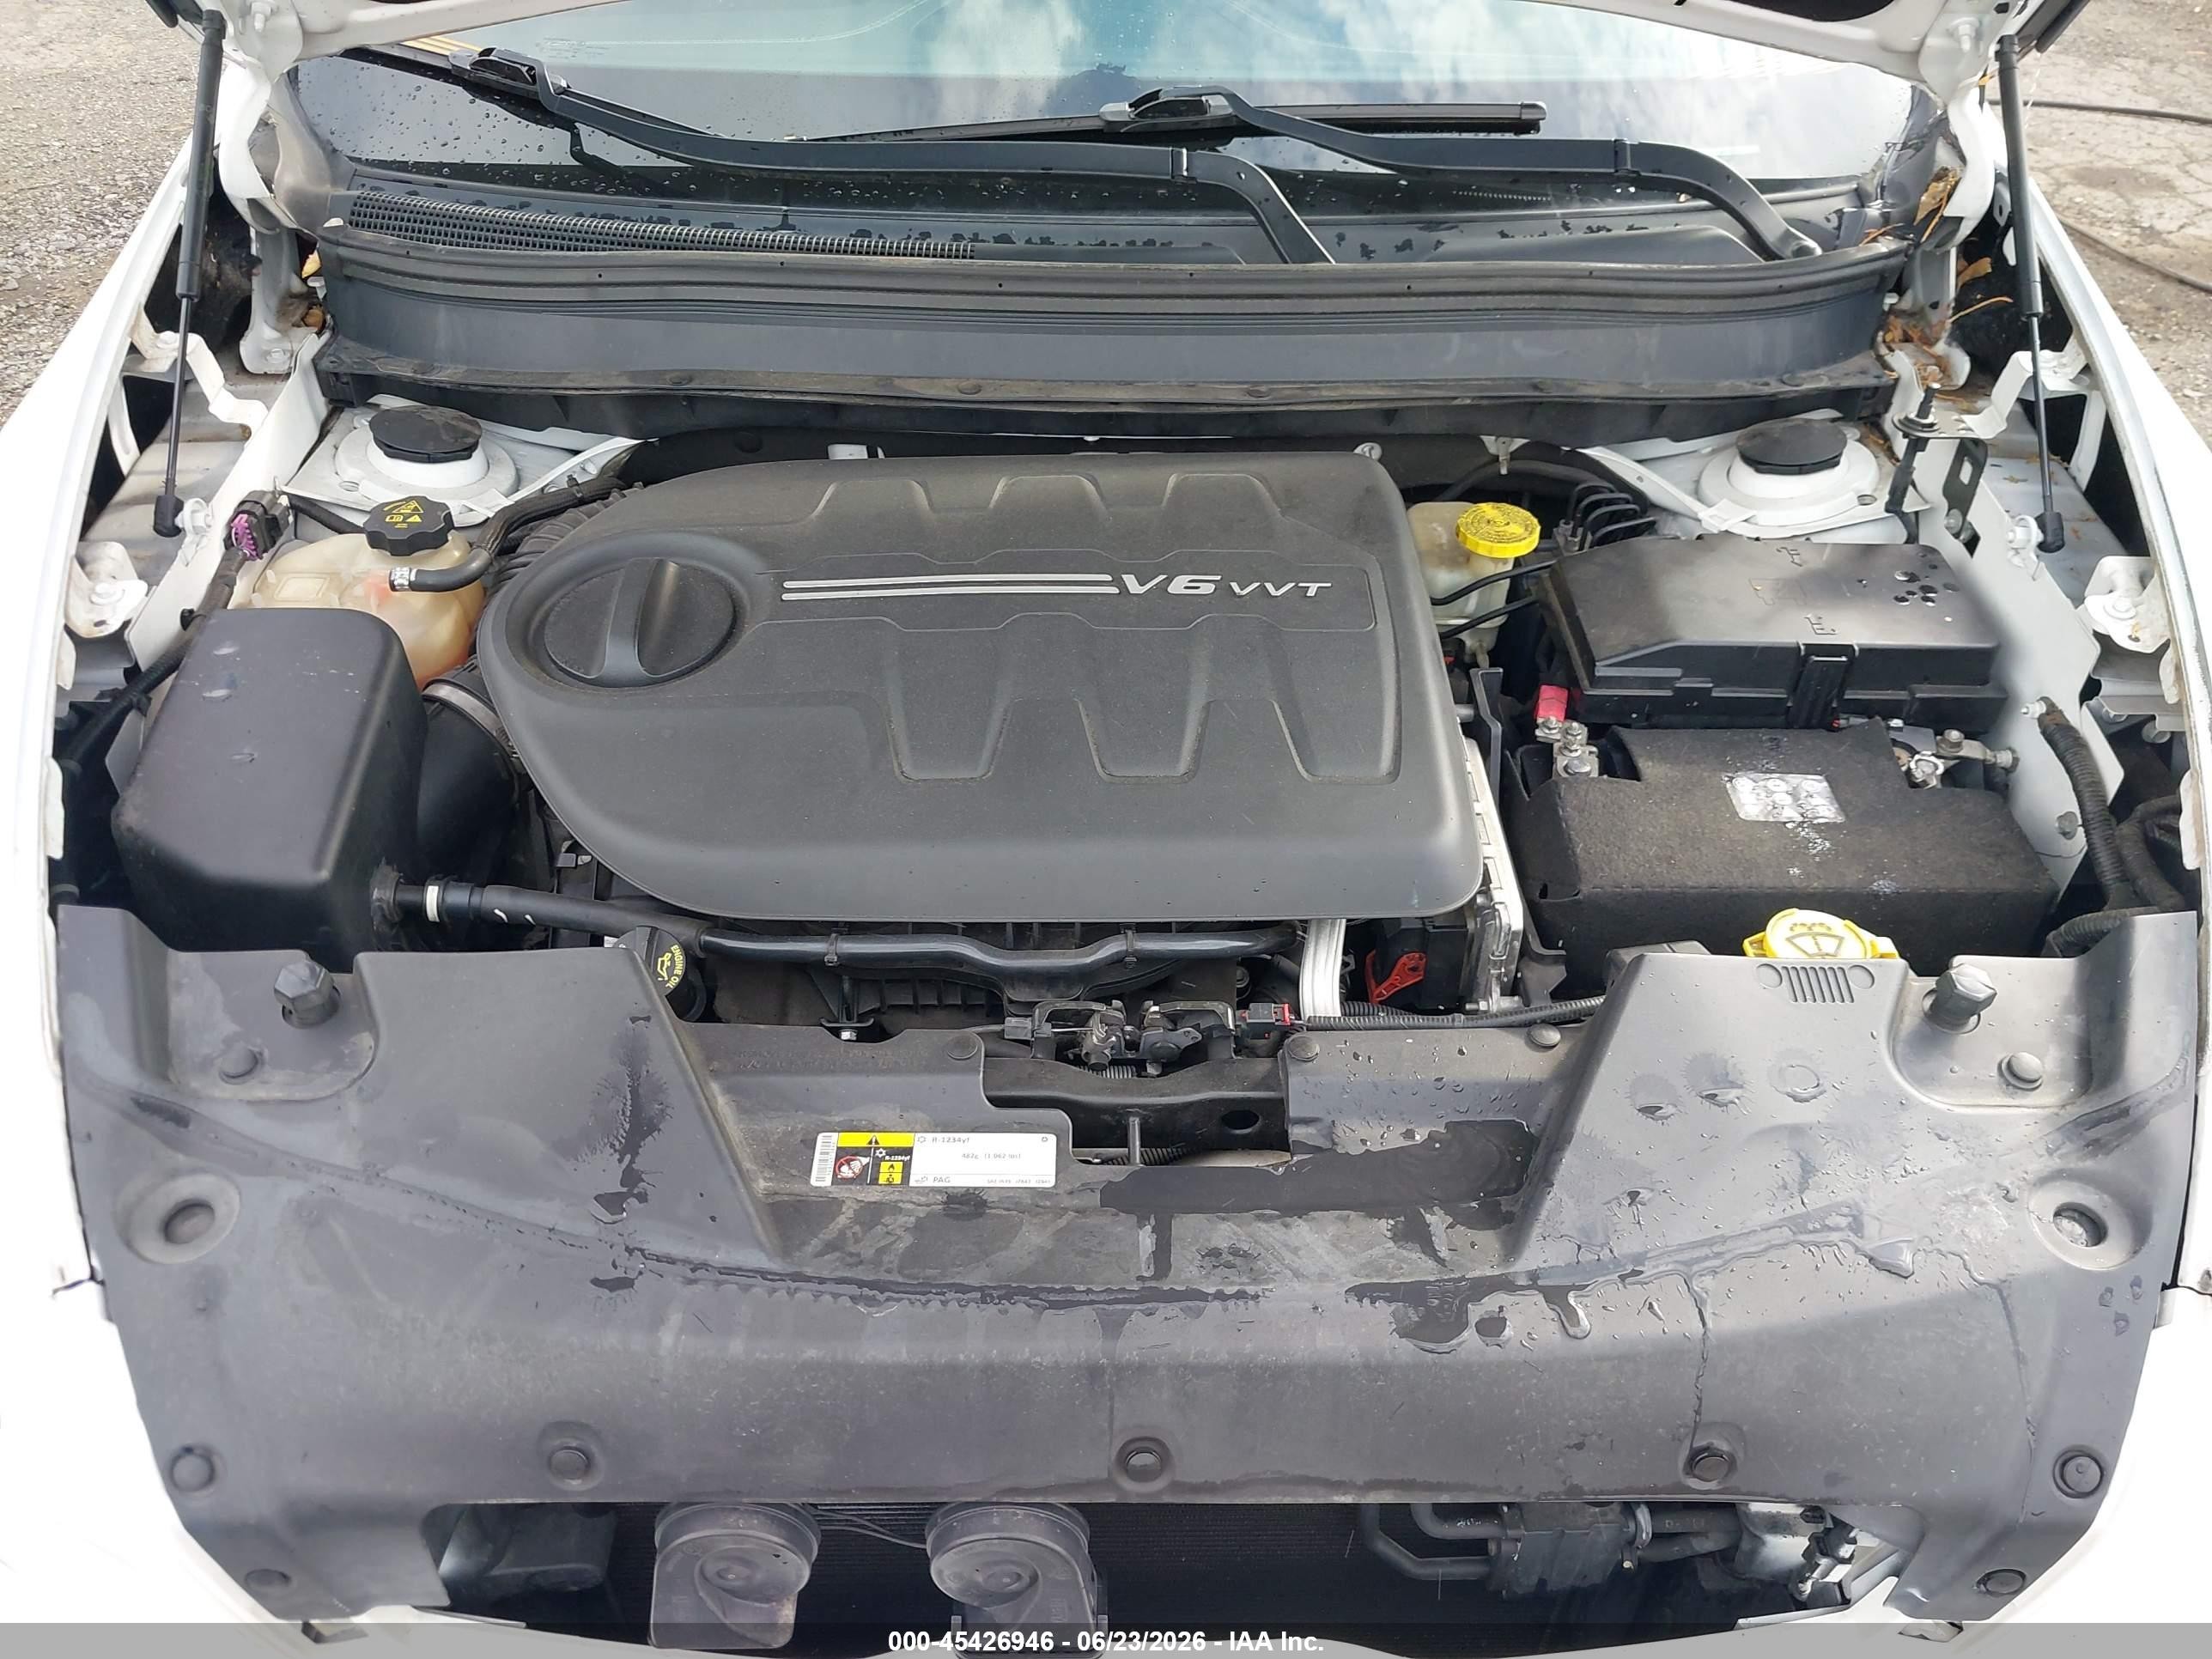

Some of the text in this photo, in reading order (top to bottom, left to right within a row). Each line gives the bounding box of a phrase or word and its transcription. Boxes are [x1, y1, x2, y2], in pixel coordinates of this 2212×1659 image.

[1121, 574, 1332, 597] V6 VVT
[665, 945, 684, 988] ENGINE OIL
